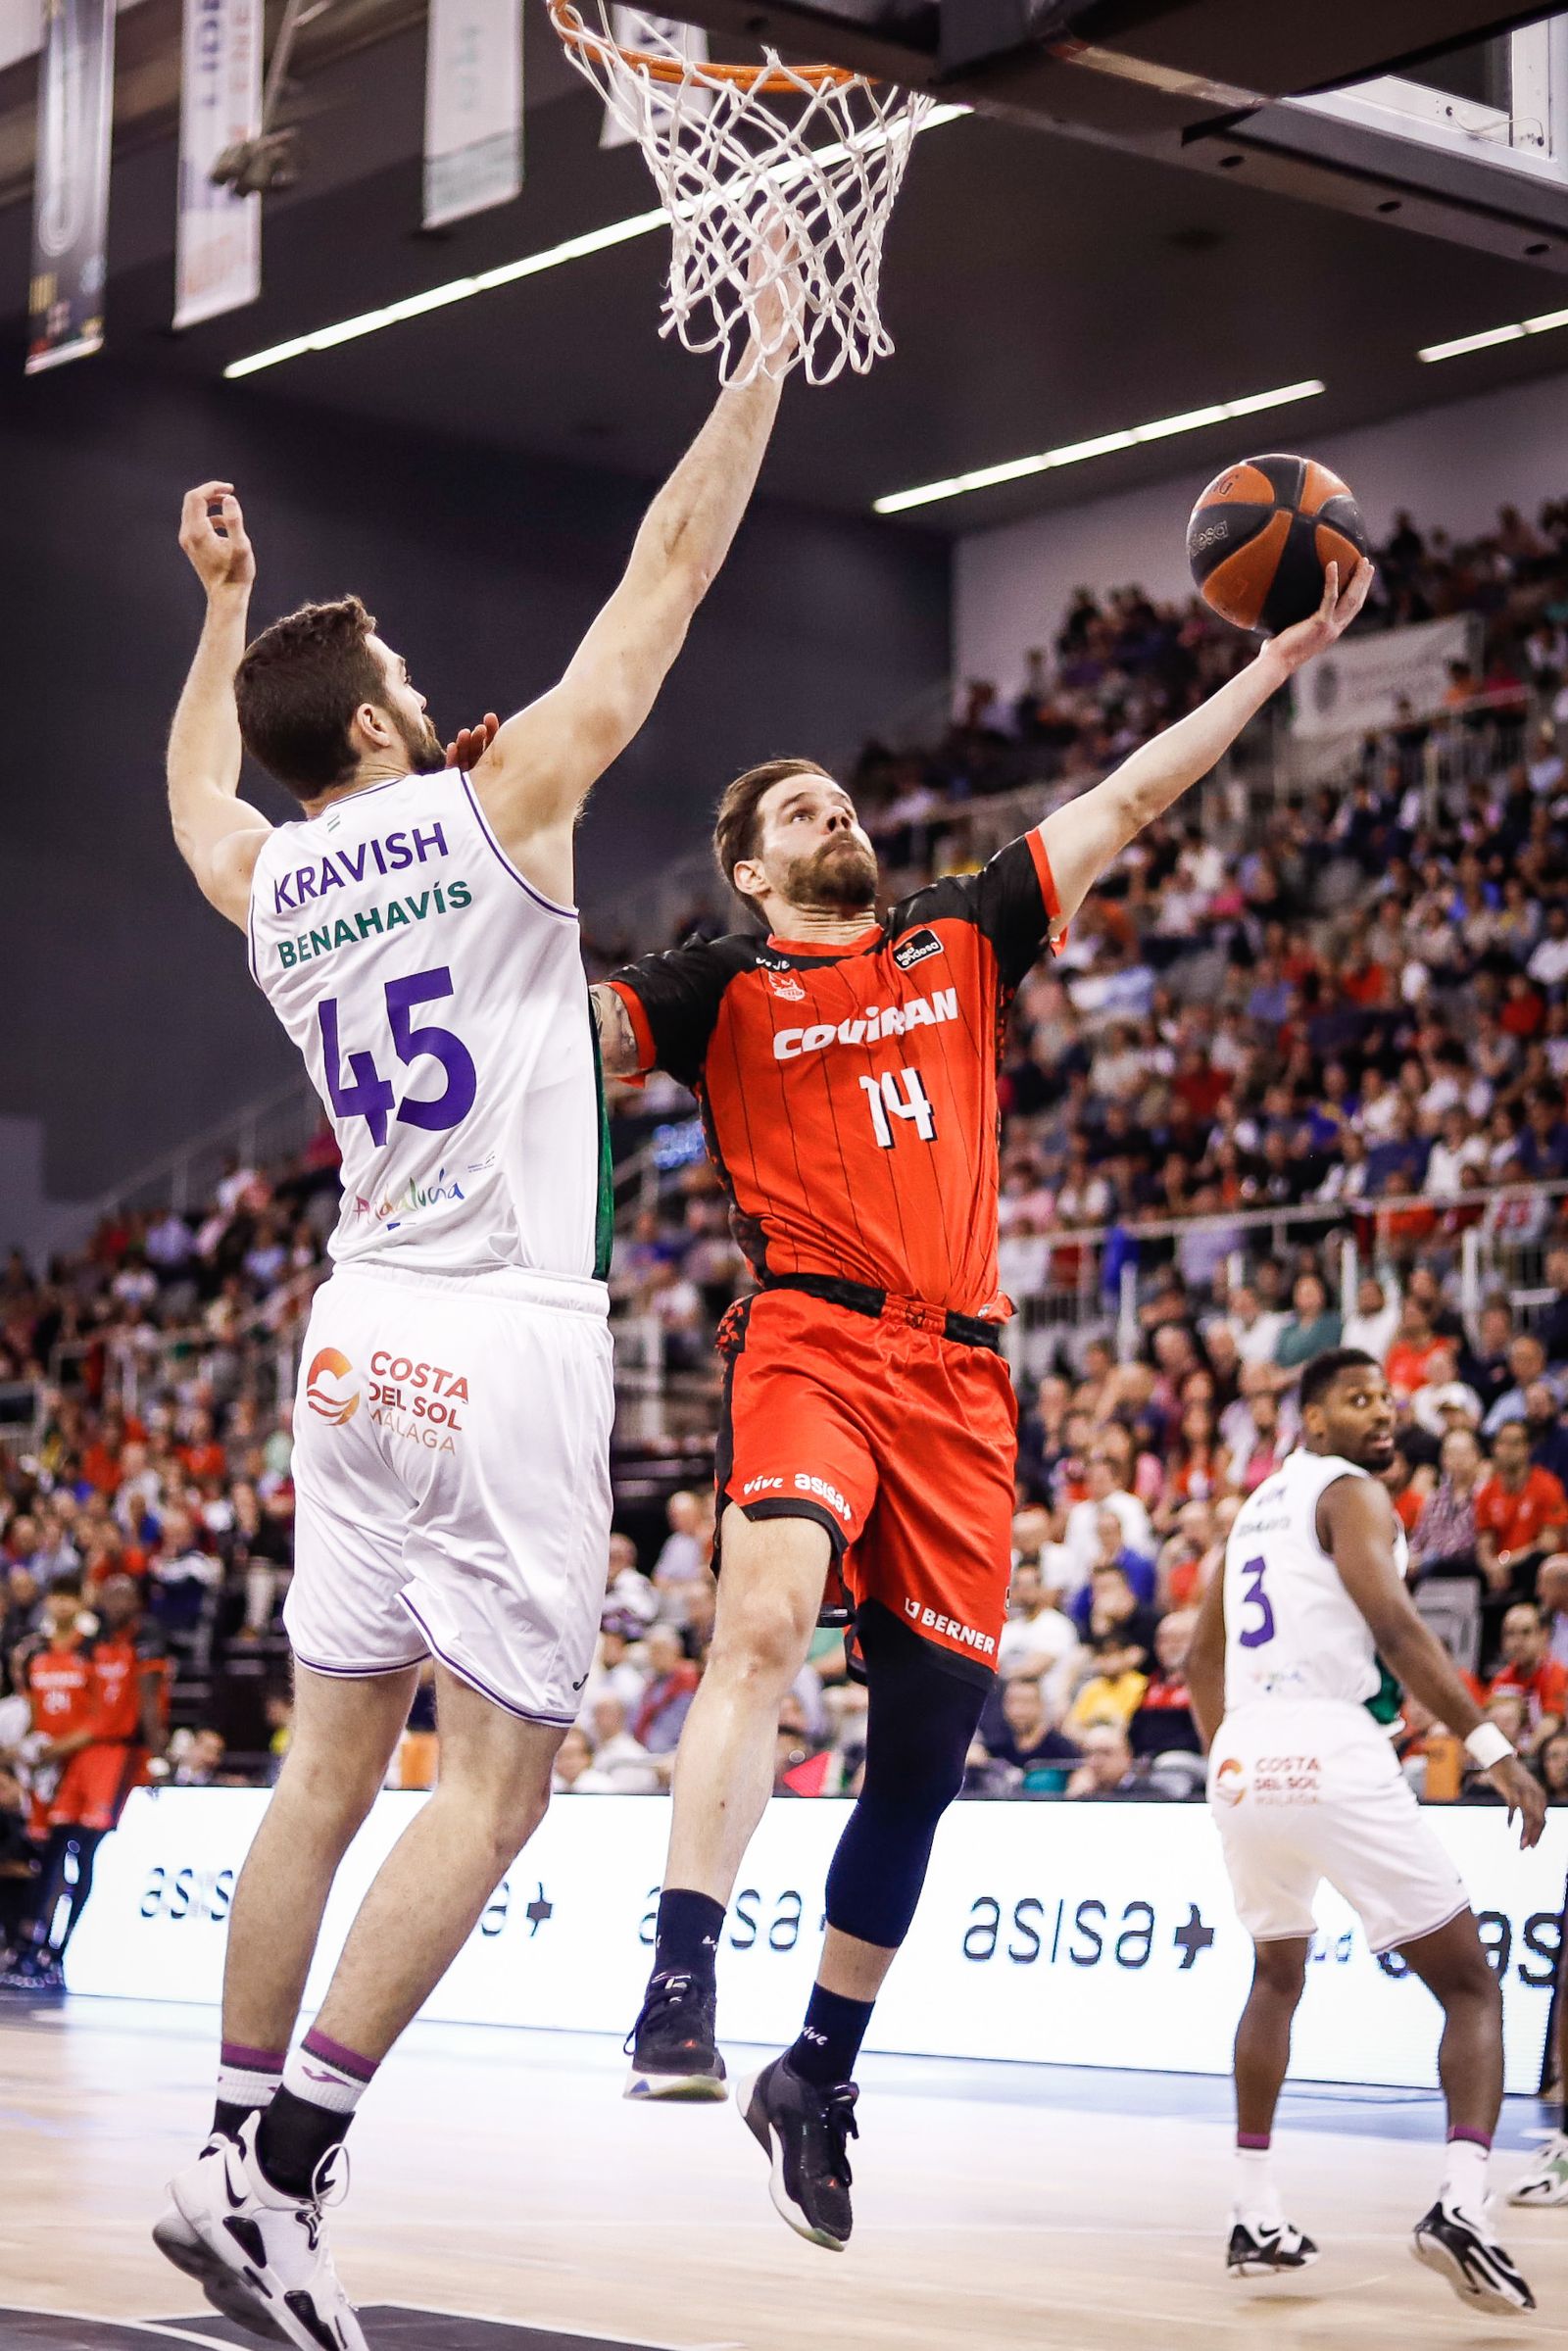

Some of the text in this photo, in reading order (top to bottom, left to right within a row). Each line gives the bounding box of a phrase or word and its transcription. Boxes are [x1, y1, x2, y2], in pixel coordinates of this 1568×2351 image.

[274, 822, 449, 914] KRAVISH
[277, 880, 472, 969] BENAHAVÍS
[318, 966, 477, 1148] 45
[858, 1066, 938, 1150] 14
[368, 1381, 463, 1432] DEL SOL
[370, 1350, 469, 1402] COSTA
[743, 1475, 784, 1495] vive
[921, 1607, 996, 1656] BERNER
[1240, 1555, 1275, 1648] 3
[1255, 1756, 1321, 1773] COSTA
[639, 1886, 803, 1951] asa
[964, 1896, 1154, 1968] asisa
